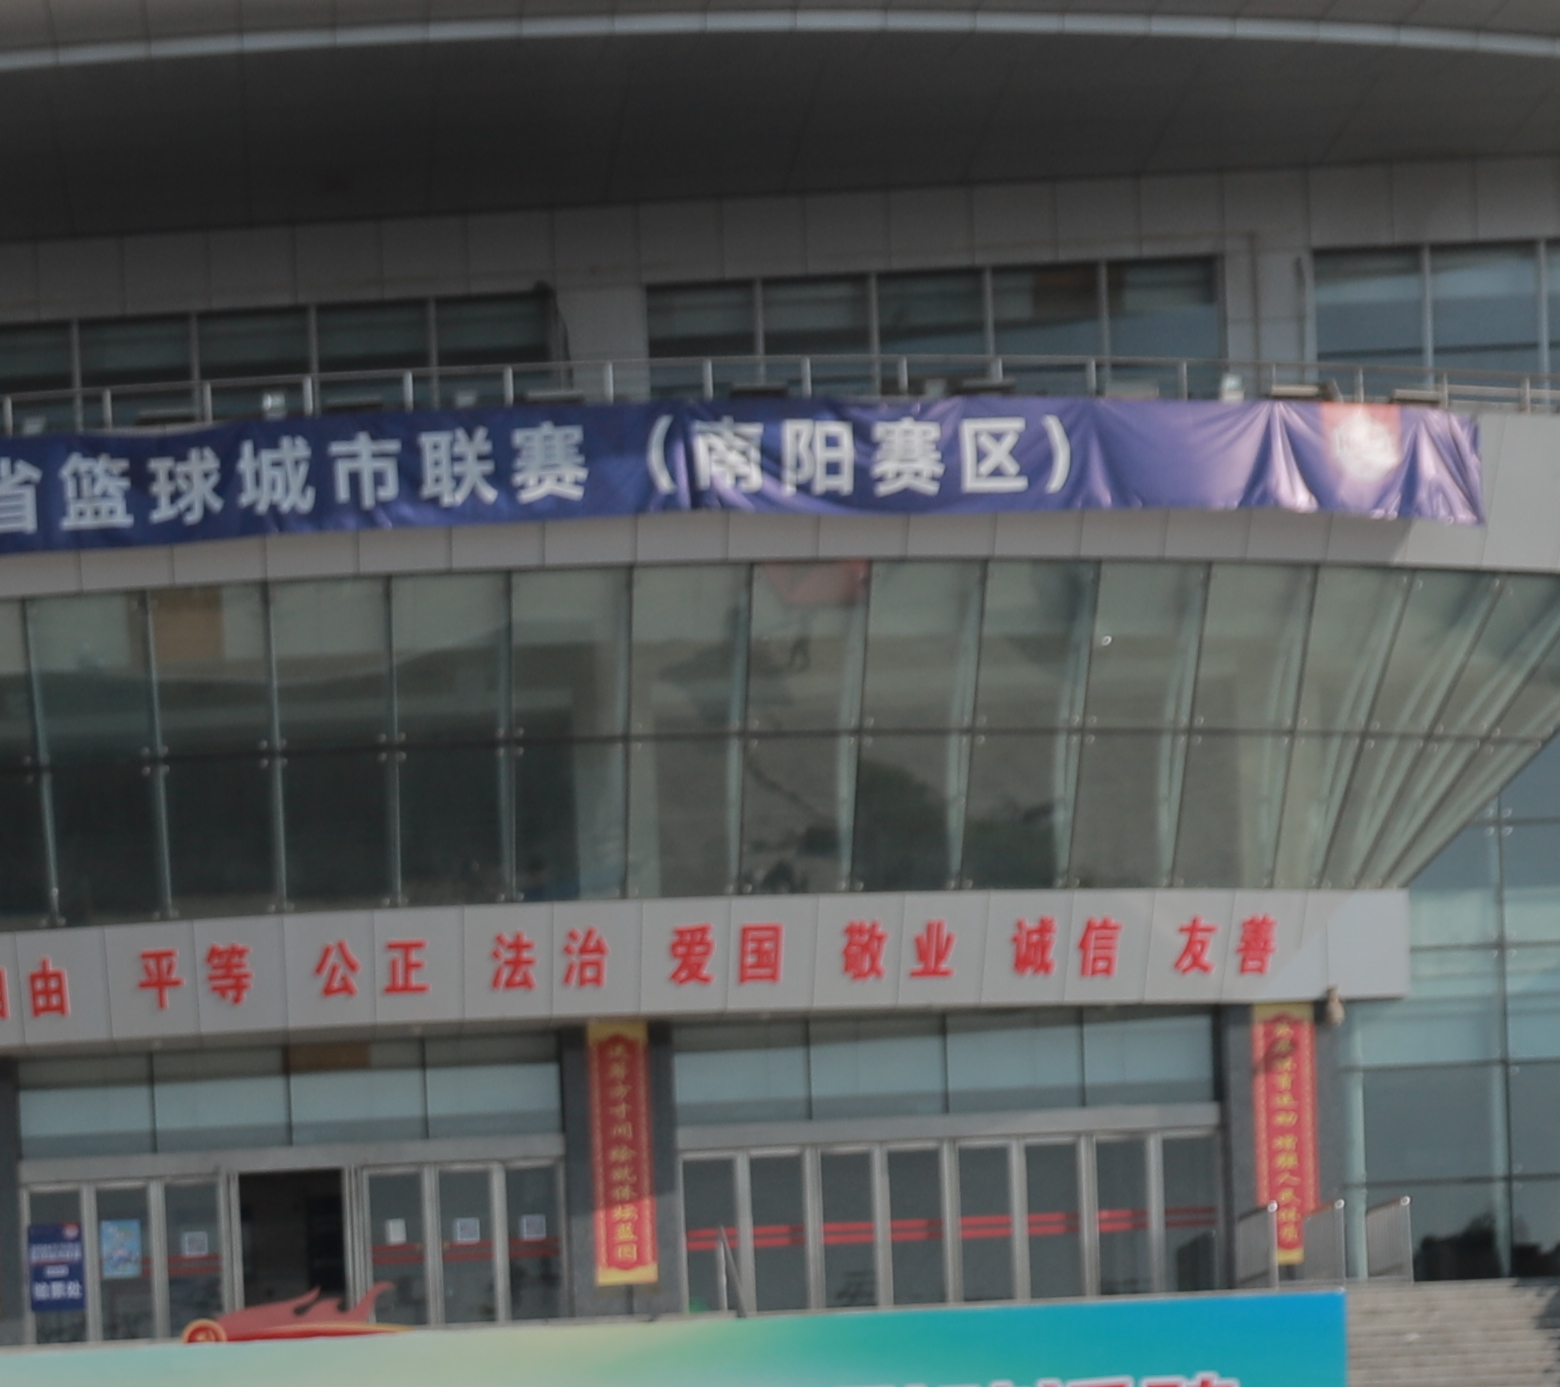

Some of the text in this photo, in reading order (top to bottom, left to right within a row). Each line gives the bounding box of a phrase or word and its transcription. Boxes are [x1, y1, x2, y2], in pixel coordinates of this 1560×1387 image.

[138, 942, 253, 1009] 平等
[313, 939, 430, 998] 公正
[491, 927, 609, 990] 法治
[668, 922, 784, 986] 爱国
[841, 919, 955, 981] 敬业
[1011, 916, 1123, 976] 诚信
[1173, 914, 1277, 975] 友善
